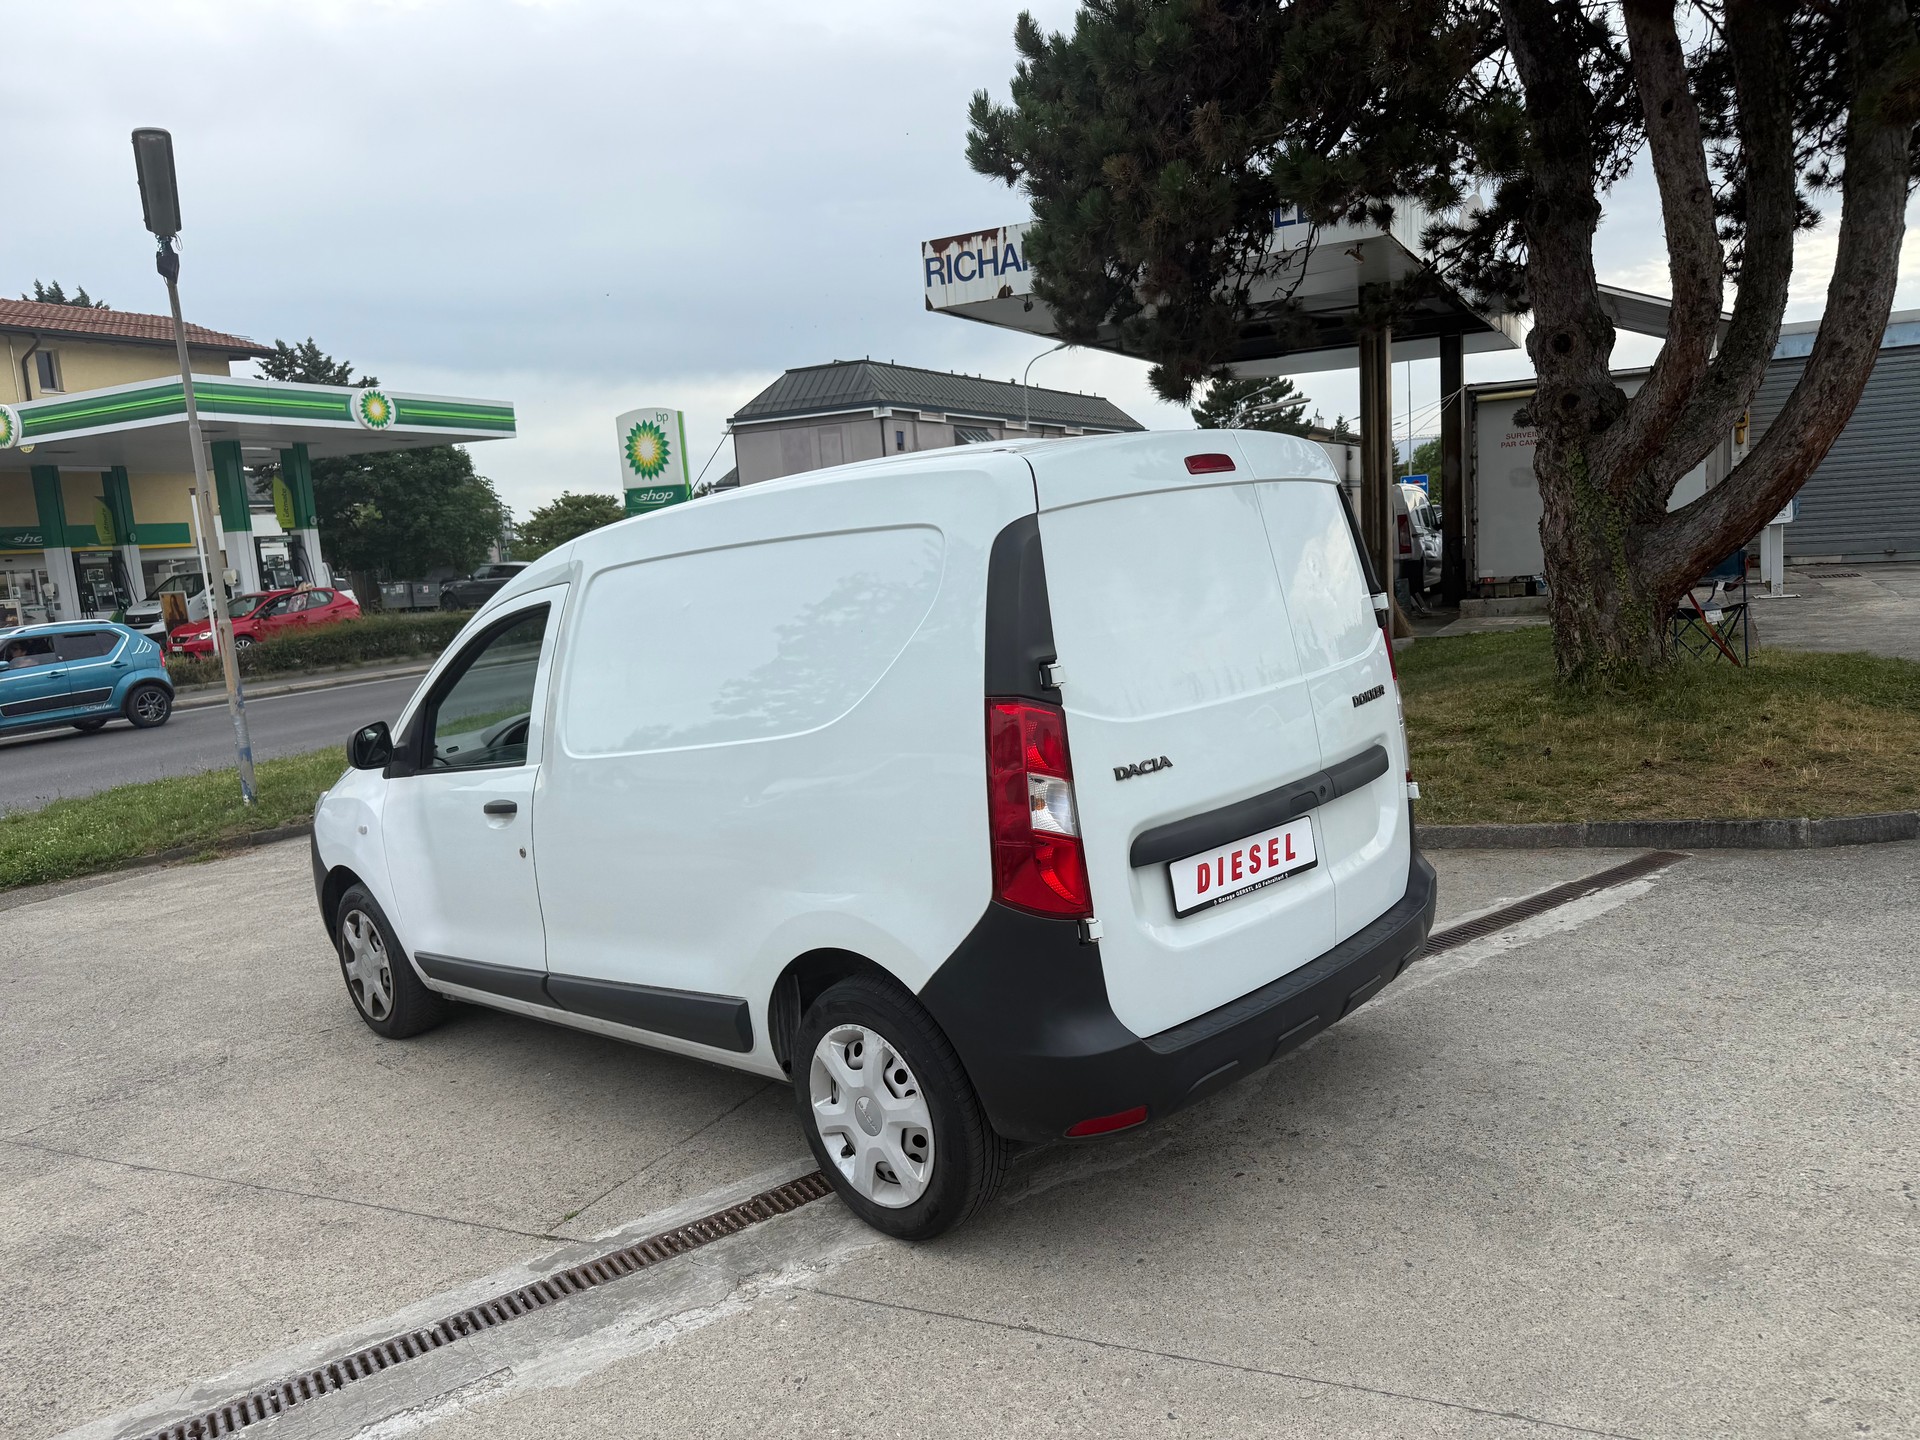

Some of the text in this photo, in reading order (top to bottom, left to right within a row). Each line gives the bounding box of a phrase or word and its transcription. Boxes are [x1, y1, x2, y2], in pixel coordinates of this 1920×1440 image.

[656, 411, 669, 424] bp
[1500, 440, 1517, 448] PAR
[640, 490, 674, 503] shop
[1352, 684, 1385, 708] DOKKER
[1113, 755, 1173, 781] DACIA
[1197, 833, 1296, 894] DIESEL
[1218, 893, 1235, 904] Garage
